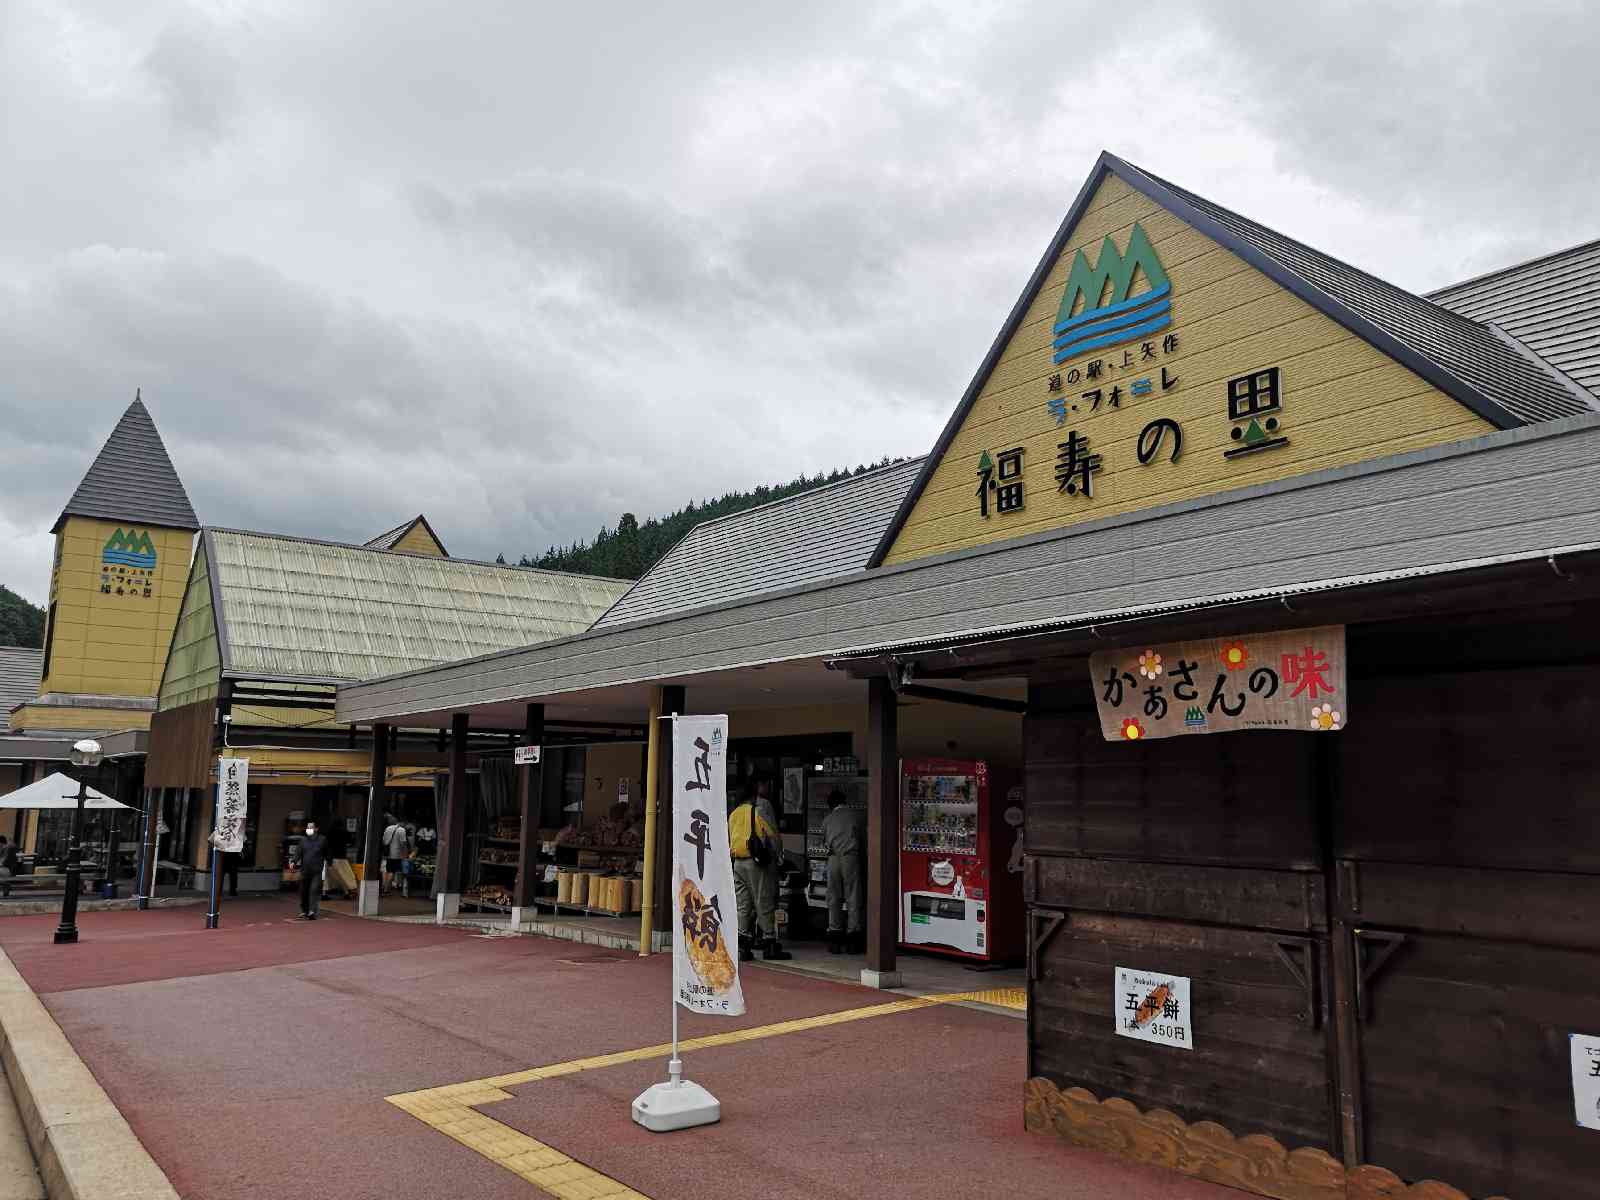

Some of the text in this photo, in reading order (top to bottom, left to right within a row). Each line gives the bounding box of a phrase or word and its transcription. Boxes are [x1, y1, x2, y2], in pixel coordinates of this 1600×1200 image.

[1047, 333, 1179, 394] 道の駅・上矢作
[1125, 992, 1180, 1022] 五平餅
[1151, 1022, 1185, 1041] 350円
